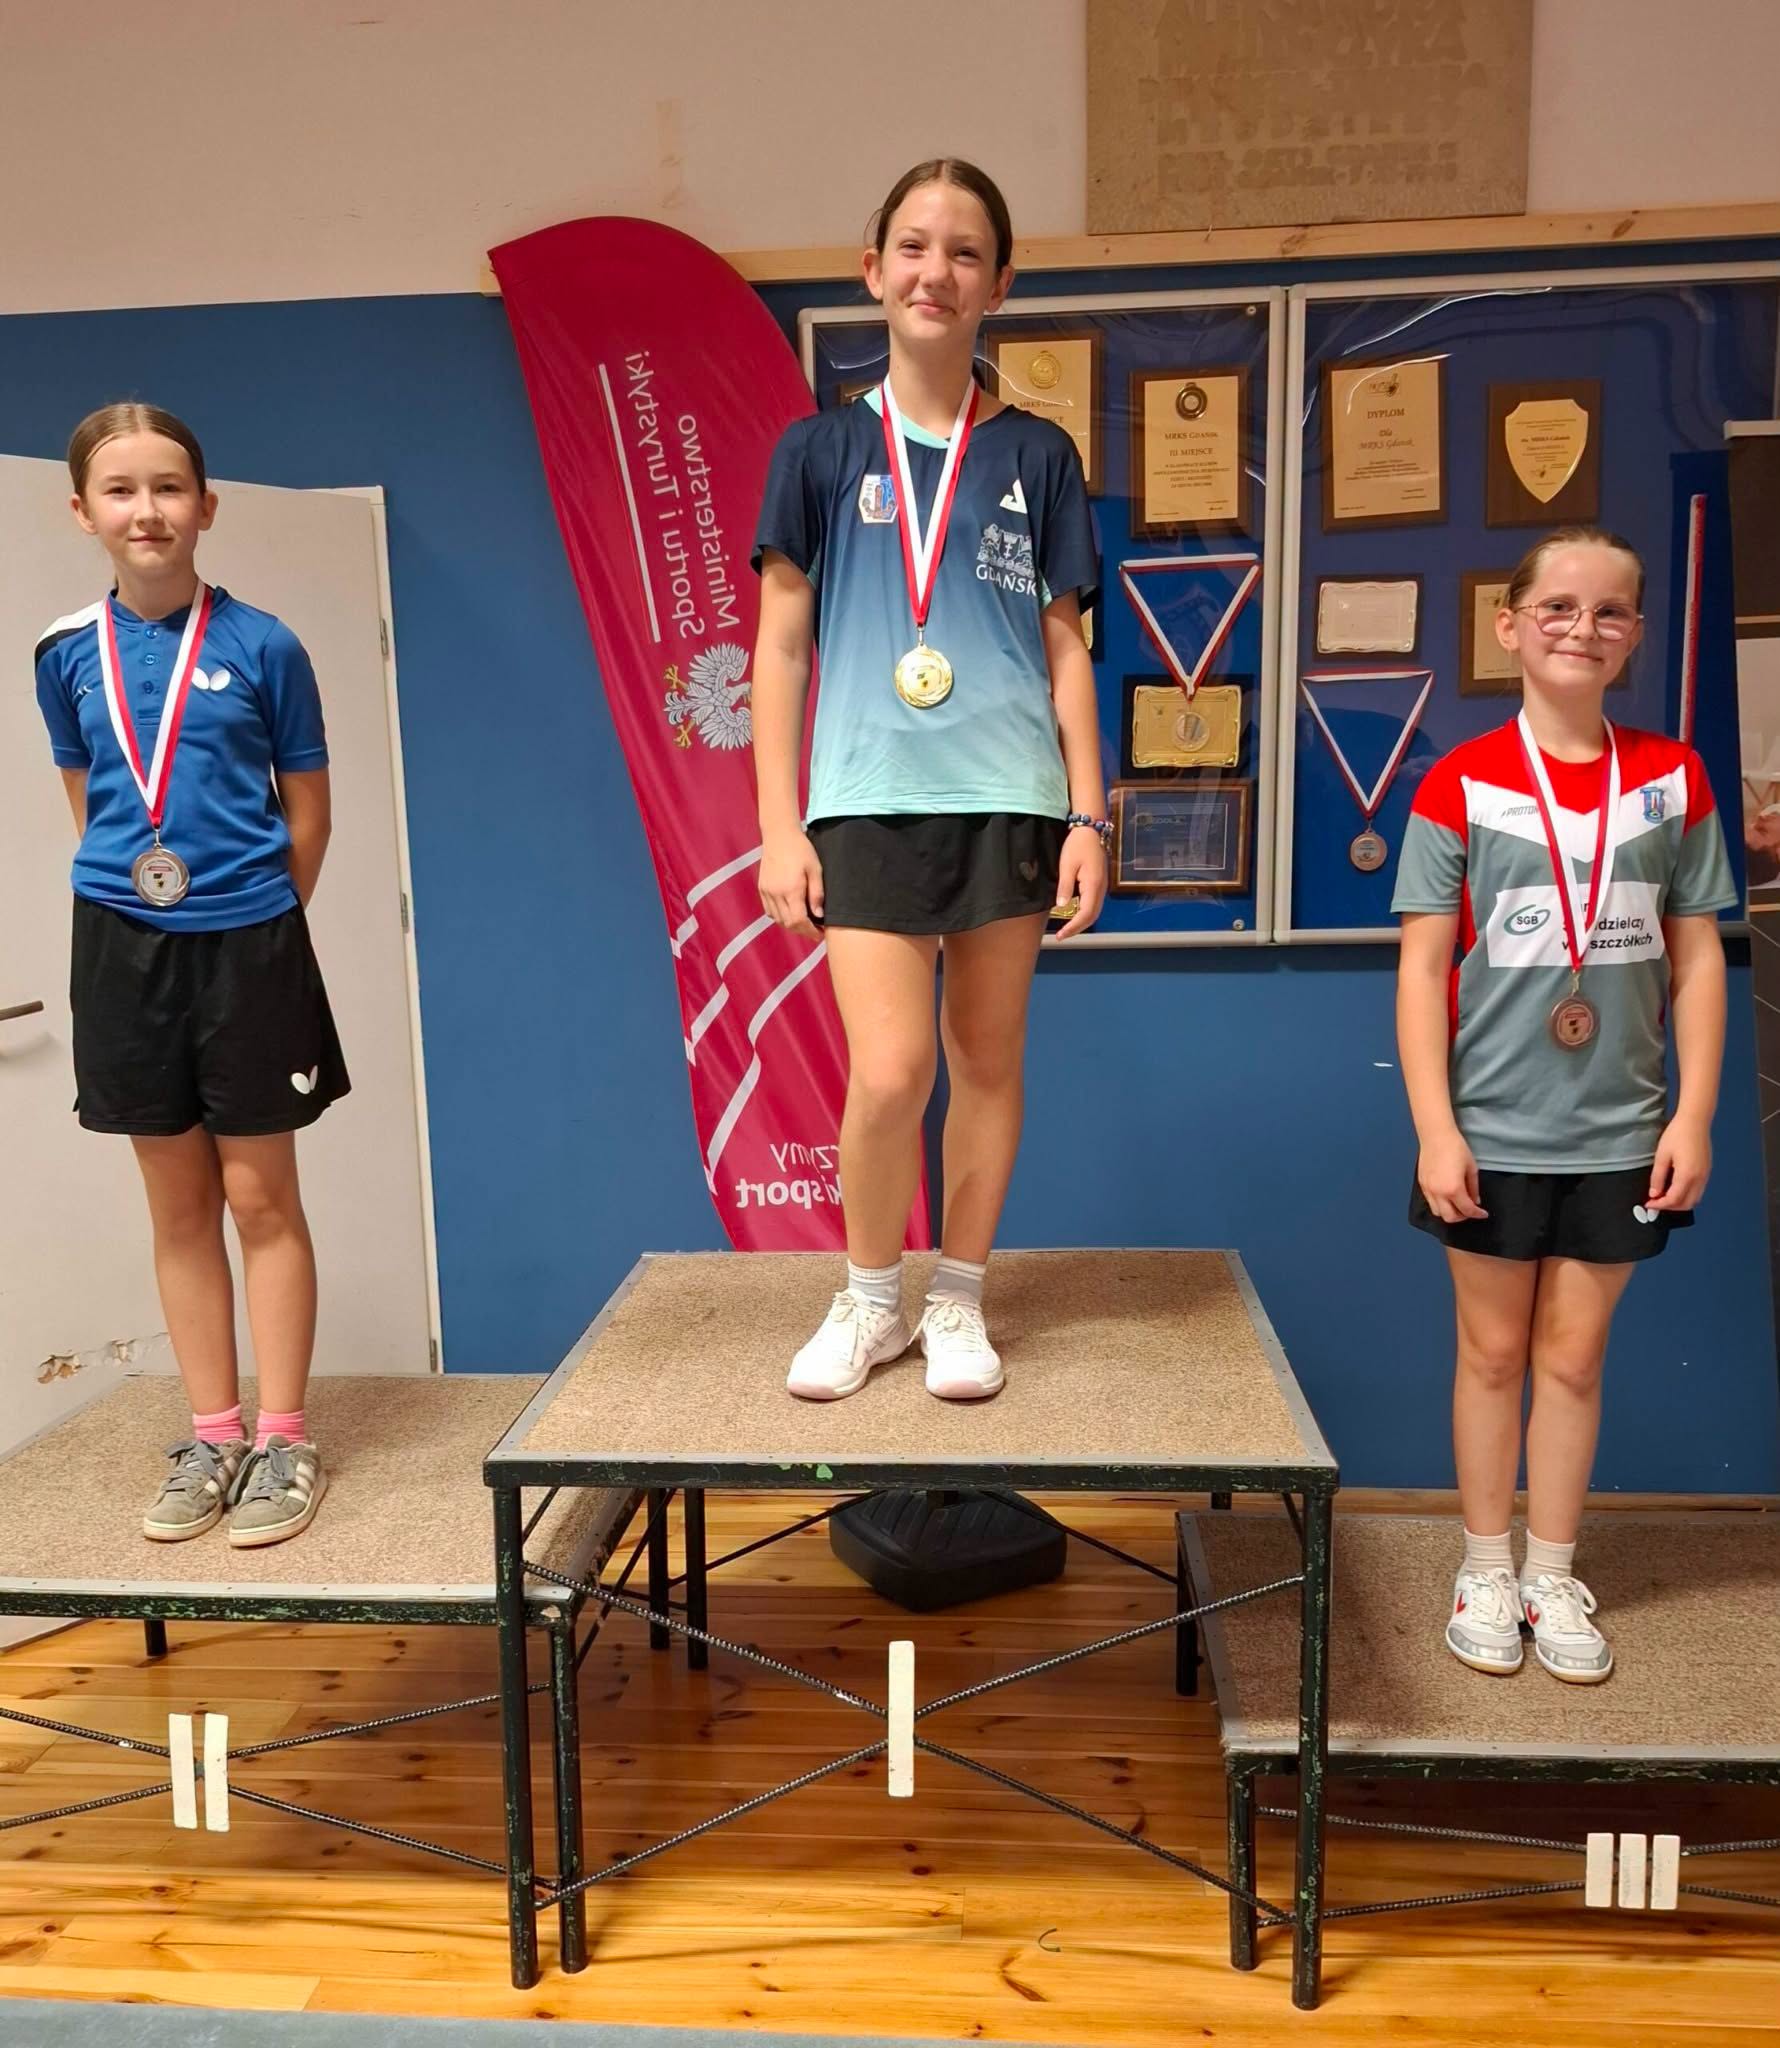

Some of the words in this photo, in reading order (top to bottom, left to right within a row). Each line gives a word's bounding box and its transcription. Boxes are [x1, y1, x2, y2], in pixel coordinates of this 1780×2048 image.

[1367, 408, 1405, 419] DYPLOM
[1181, 447, 1213, 456] MIEJSCE
[1516, 915, 1539, 926] SGB
